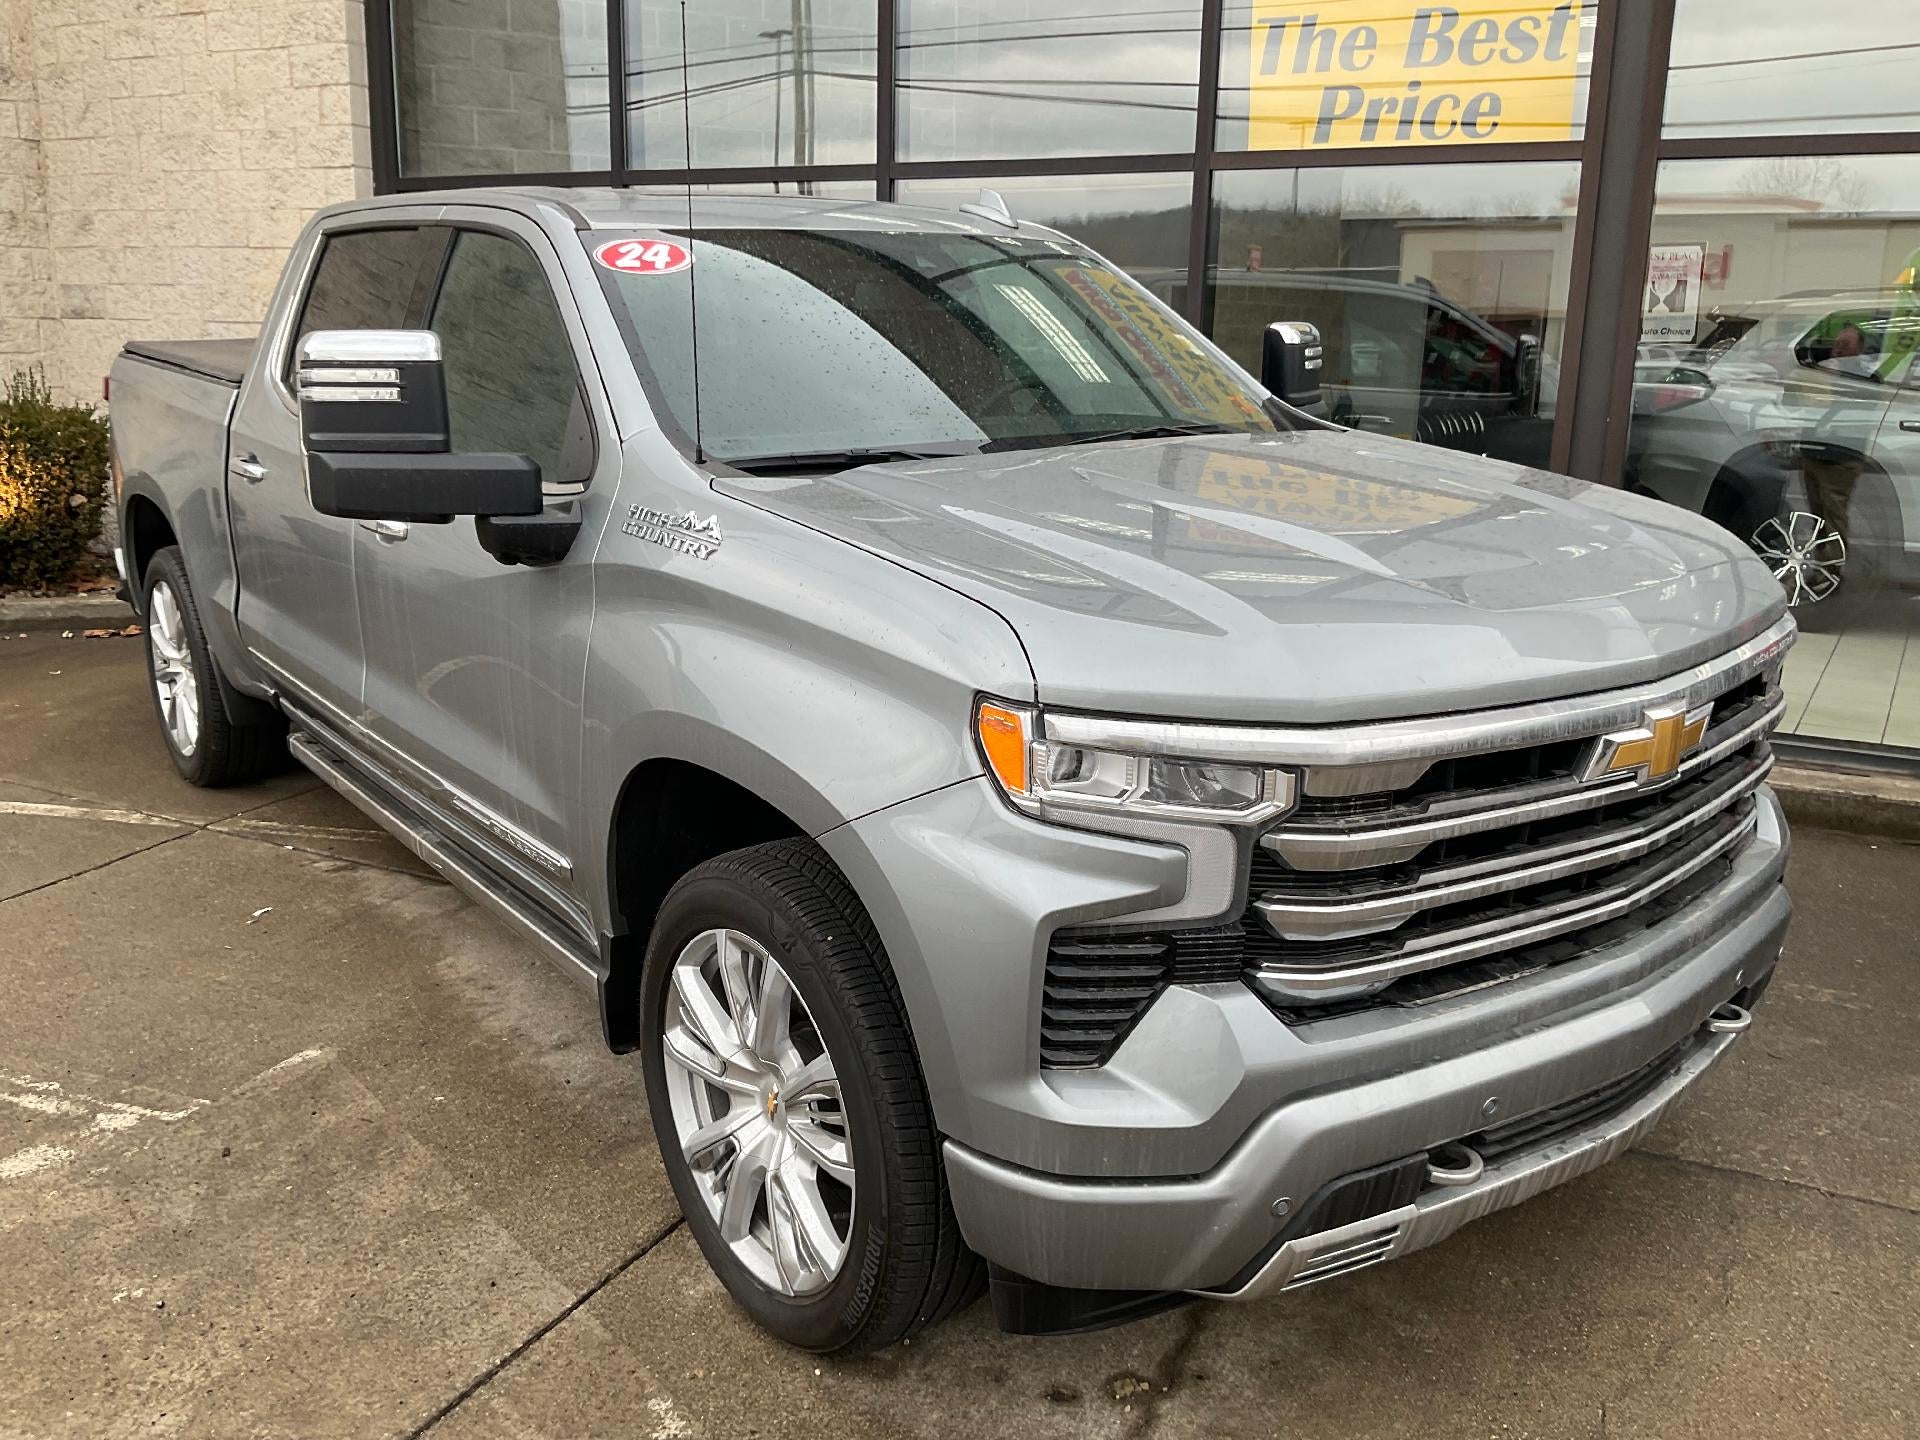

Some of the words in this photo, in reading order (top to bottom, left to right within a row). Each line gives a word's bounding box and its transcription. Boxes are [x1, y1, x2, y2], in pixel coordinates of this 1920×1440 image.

[1257, 13, 1378, 76] The
[1403, 0, 1577, 69] Best
[1312, 80, 1502, 144] Price
[614, 242, 671, 270] 24
[1660, 327, 1691, 335] Choice
[621, 521, 719, 561] COUNTRY
